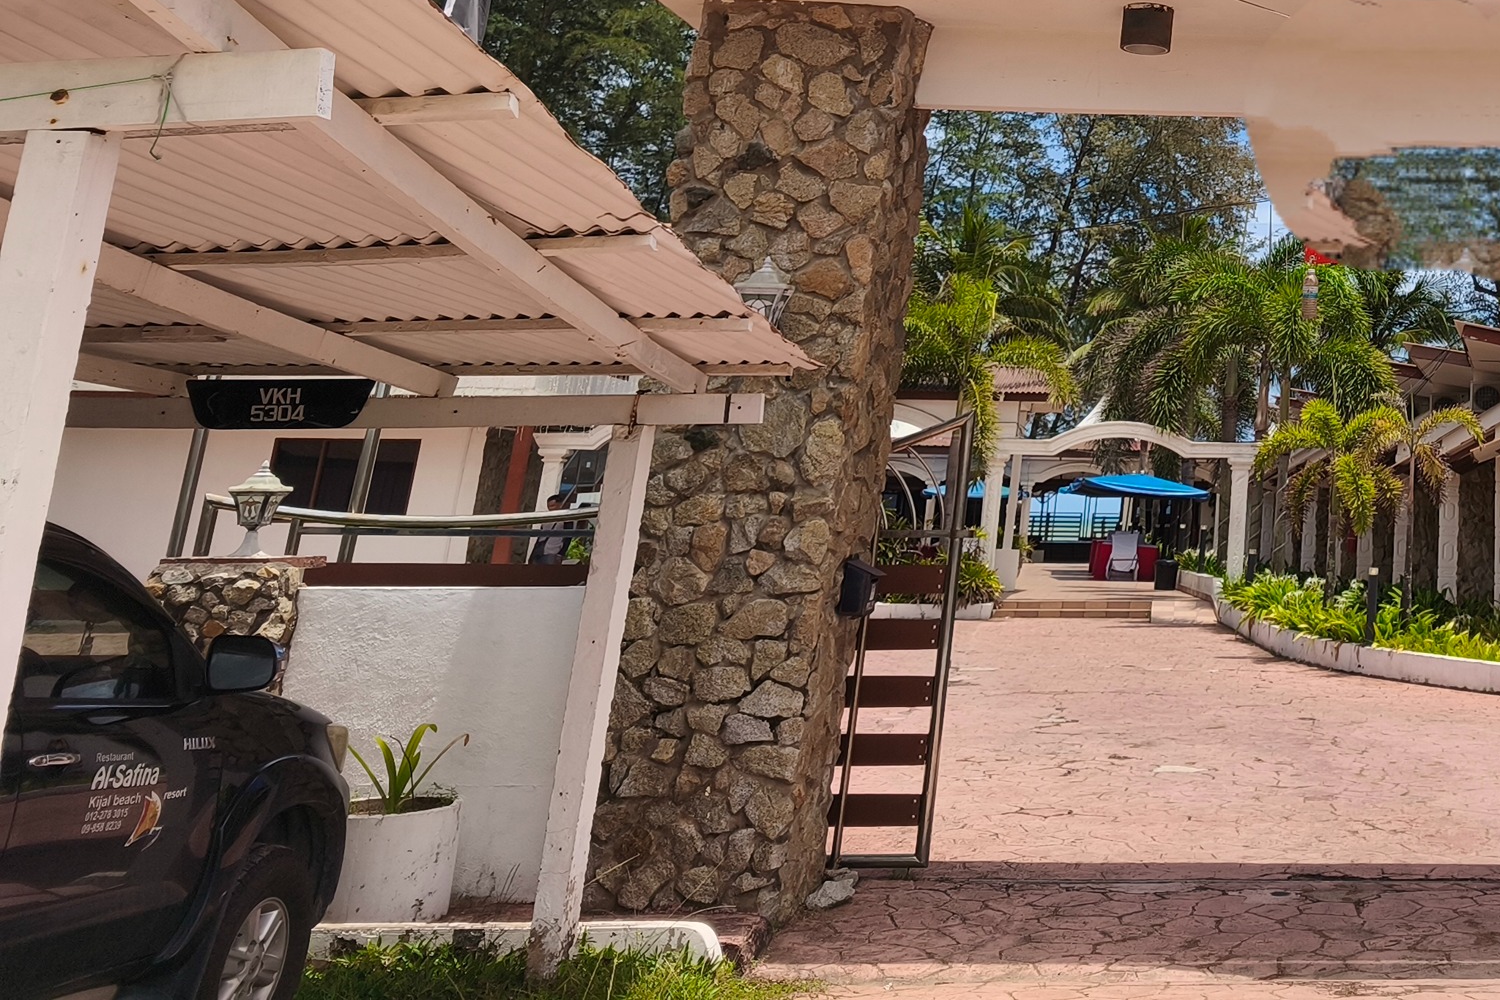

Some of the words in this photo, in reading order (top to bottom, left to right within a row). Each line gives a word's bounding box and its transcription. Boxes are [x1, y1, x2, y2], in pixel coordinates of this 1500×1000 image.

[259, 387, 302, 405] VKH
[250, 404, 305, 422] 5304
[183, 736, 216, 751] HILUX
[96, 751, 135, 763] Restaurant
[90, 762, 160, 791] Al-Safina
[88, 796, 112, 810] Kijal
[112, 792, 142, 806] beach
[163, 787, 188, 800] resort
